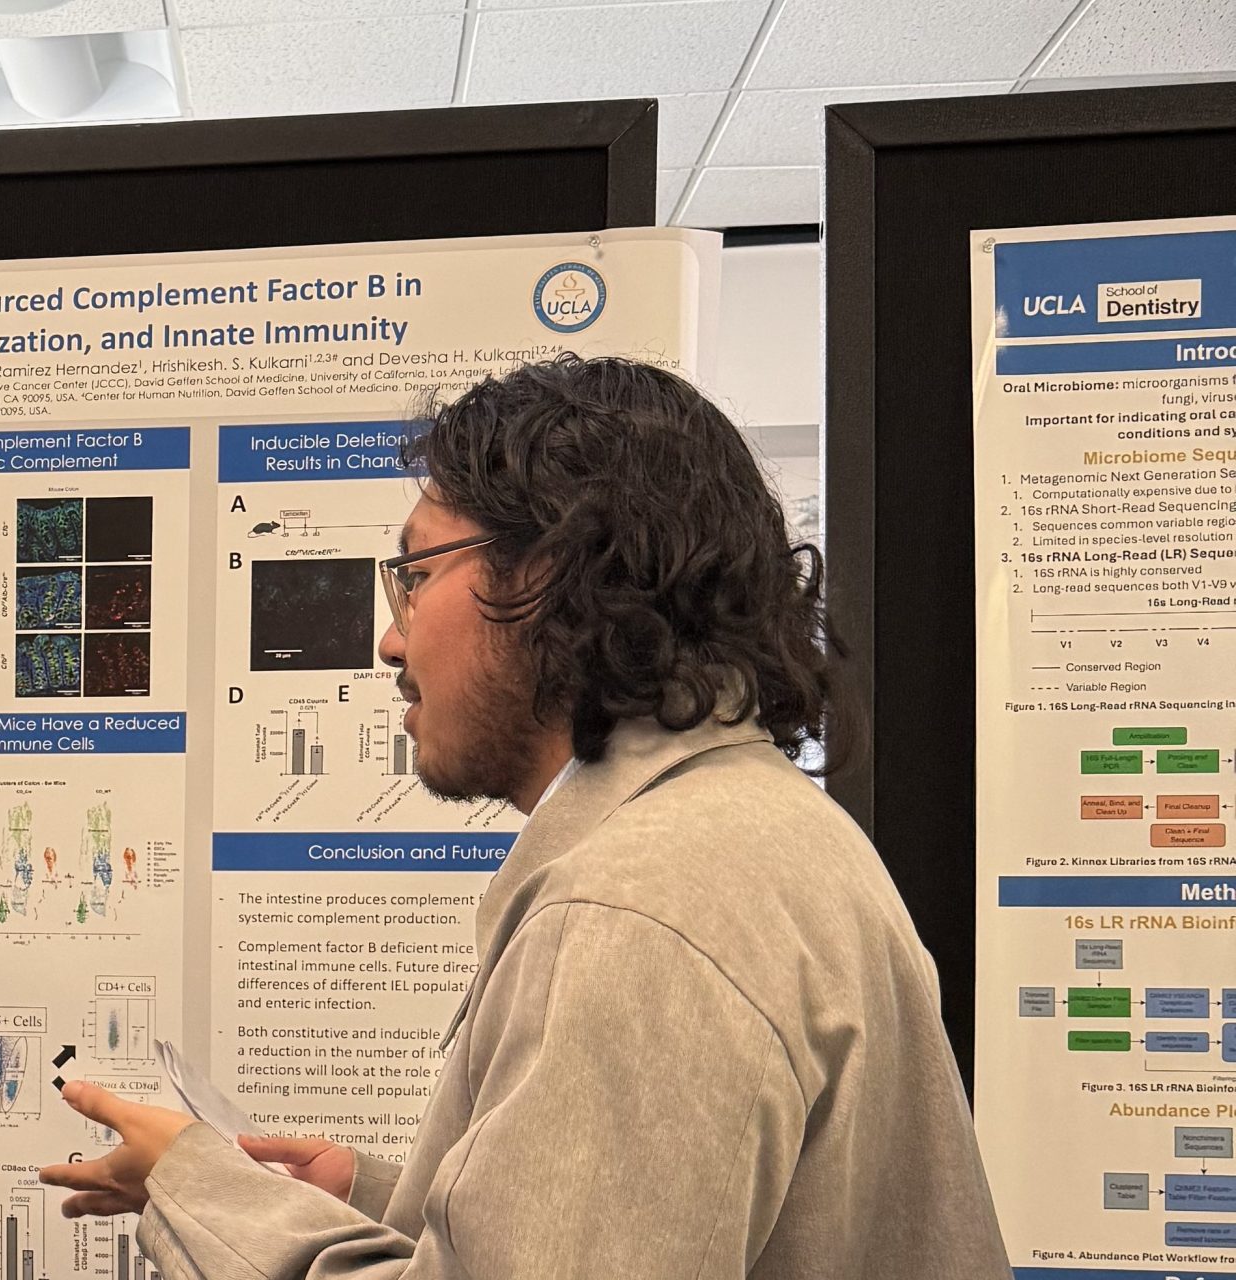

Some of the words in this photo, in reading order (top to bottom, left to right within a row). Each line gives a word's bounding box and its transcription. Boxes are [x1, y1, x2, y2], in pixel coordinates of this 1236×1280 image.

[73, 281, 258, 311] Complement
[268, 278, 359, 302] Factor
[368, 274, 386, 298] B
[396, 272, 421, 297] in
[1106, 285, 1146, 297] School
[1146, 284, 1158, 295] of
[546, 299, 593, 317] UCLA
[1024, 294, 1086, 316] UCLA
[1107, 298, 1199, 317] Dentistry
[101, 323, 153, 350] and
[164, 323, 255, 348] Innate
[265, 316, 408, 346] Immunity
[1003, 382, 1031, 393] Oral
[1034, 380, 1119, 393] Microbiome:
[1122, 375, 1229, 390] microorganisms
[1025, 414, 1093, 428] Important
[1096, 413, 1115, 424] for
[1118, 410, 1187, 424] indicating
[1189, 409, 1217, 421] oral
[76, 432, 129, 448] Factor
[133, 432, 143, 447] B
[251, 434, 331, 451] Inducible
[336, 432, 408, 448] Deletion
[10, 453, 118, 470] Complement
[266, 455, 322, 471] Results
[326, 454, 341, 469] in
[1083, 449, 1187, 465] Microbiome
[1065, 662, 1122, 672] Conserved
[1124, 661, 1161, 673] Region
[1005, 702, 1035, 713] Figure
[1037, 702, 1047, 711] 1.
[1049, 702, 1069, 711] 16S
[1070, 701, 1127, 713] Long-Read
[41, 717, 84, 731] Have
[88, 719, 100, 731] a
[104, 716, 180, 731] Reduced
[57, 736, 95, 751] Cells
[308, 844, 405, 860] Conclusion
[410, 844, 446, 860] and
[452, 845, 507, 862] Future
[238, 892, 263, 905] The
[266, 893, 322, 905] intestine
[326, 893, 387, 907] produces
[390, 893, 475, 908] complement
[1064, 915, 1094, 929] 16s
[1100, 915, 1124, 929] LR
[1129, 915, 1178, 930] rRNA
[13, 1015, 42, 1027] Cells
[238, 1025, 268, 1038] Both
[271, 1027, 349, 1039] constitutive
[351, 1027, 376, 1039] and
[380, 1027, 441, 1040] inducible
[1109, 1102, 1211, 1118] Abundance
[1032, 1249, 1065, 1261] Figure
[1066, 1250, 1077, 1260] 4.
[1078, 1251, 1140, 1261] Abundance
[1142, 1252, 1164, 1262] Plot
[1165, 1253, 1218, 1263] Workflow
